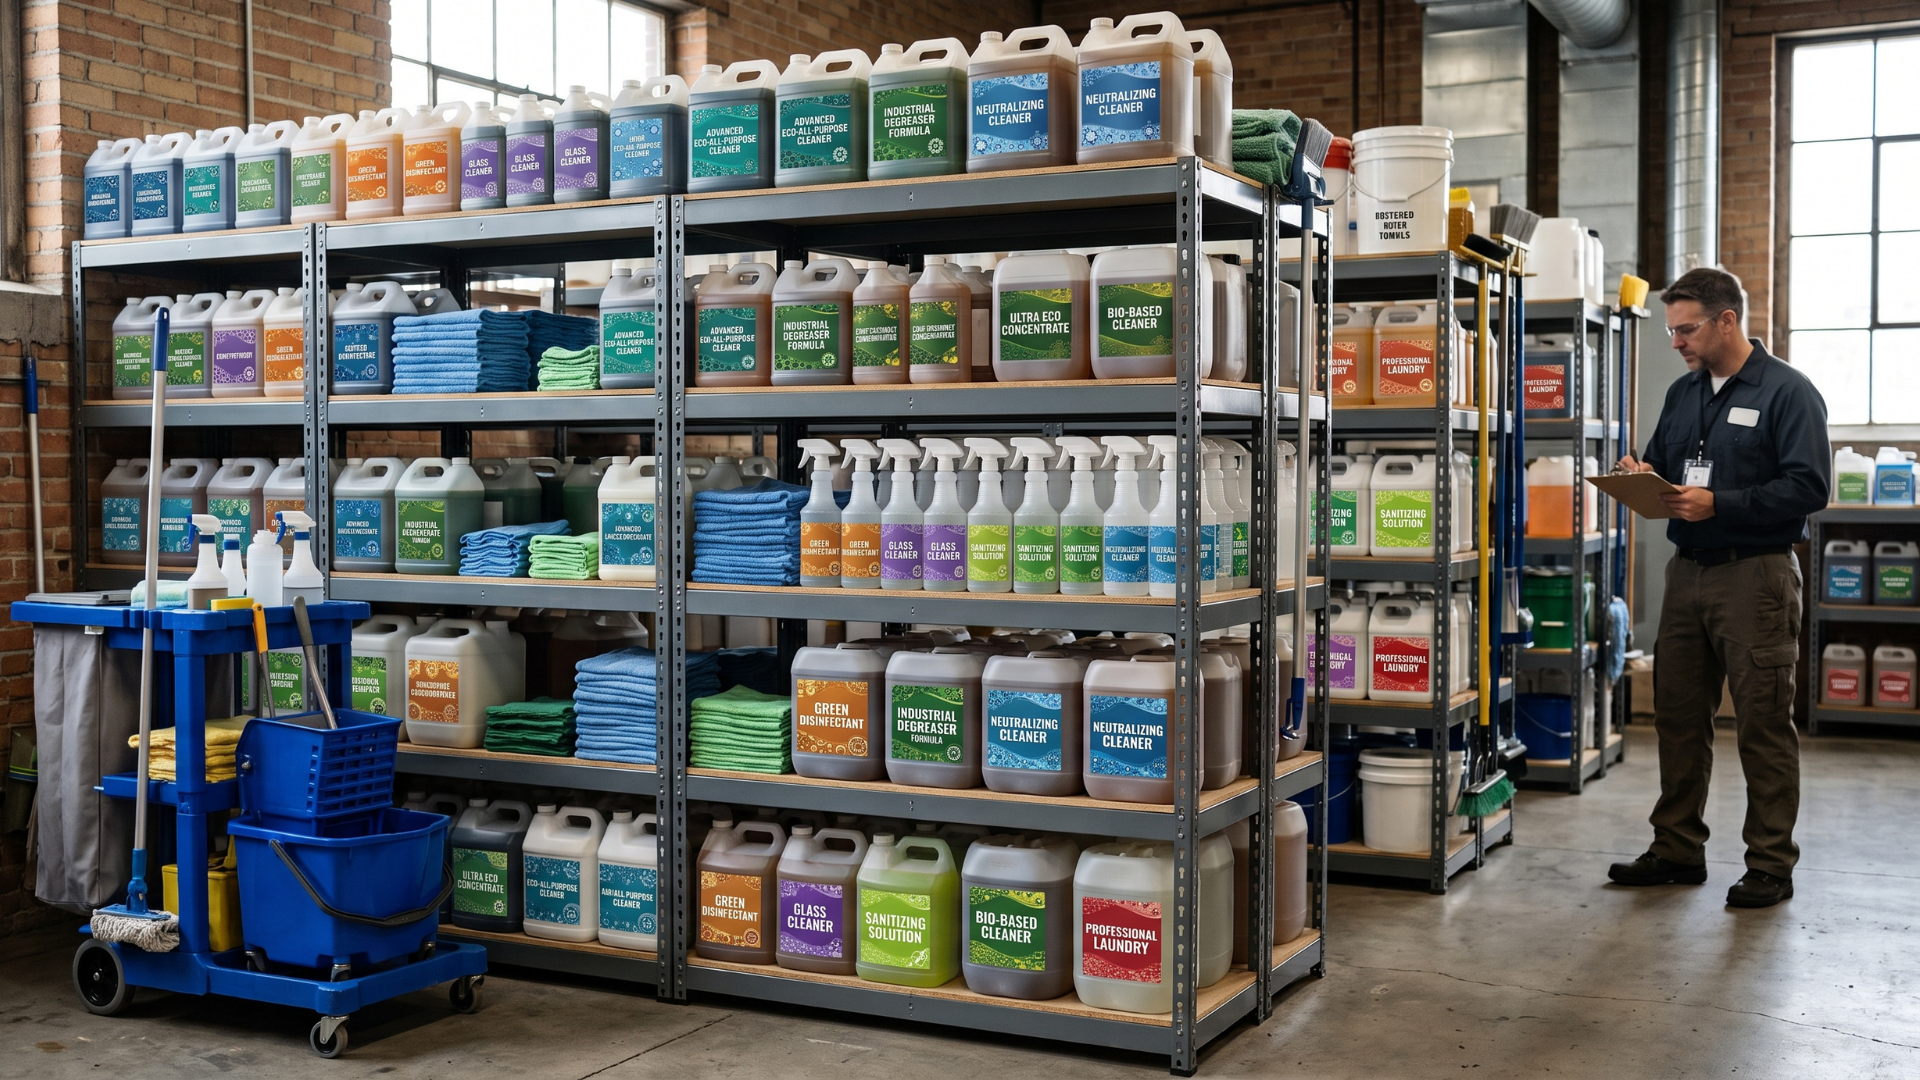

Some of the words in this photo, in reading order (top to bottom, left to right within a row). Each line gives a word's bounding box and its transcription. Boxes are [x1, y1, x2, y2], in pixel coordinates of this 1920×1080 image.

[1085, 87, 1156, 106] NEUTRALIZING
[884, 102, 936, 117] INDUSTRIAL
[975, 98, 1044, 116] NEUTRALIZING
[1098, 101, 1143, 116] CLEANER
[794, 114, 835, 126] ADVANCED
[883, 113, 935, 128] DEGREASER
[988, 112, 1032, 126] CLEANER
[706, 125, 744, 137] ADVANCED
[782, 123, 848, 138] ECO-ALL-PURPOSE
[888, 124, 931, 138] FORMULA
[694, 133, 757, 147] ECO-ALL-PURPOSE
[797, 134, 832, 146] CLEANER
[565, 147, 587, 157] GLASS
[709, 144, 741, 155] CLEANER
[469, 158, 489, 168] GLASS
[511, 162, 540, 173] CLEANER
[560, 155, 591, 167] CLEANER
[465, 166, 493, 177] CLEANER
[1010, 312, 1039, 324] ULTRA
[1042, 311, 1061, 322] ECO
[1107, 305, 1163, 319] BIO-BASED
[783, 320, 829, 331] INDUSTRIAL
[1001, 322, 1070, 336] CONCENTRATE
[1112, 318, 1158, 331] CLEANER
[783, 330, 830, 341] DEGREASER
[616, 346, 642, 355] CLEANER
[712, 343, 741, 352] CLEANER
[787, 340, 826, 351] FORMULA
[1382, 357, 1431, 365] PROFESSIONAL
[1388, 365, 1425, 374] LAUNDRY
[1380, 508, 1426, 519] SANITIZING
[1382, 518, 1423, 528] SOLUTION
[888, 541, 913, 551] GLASS
[930, 542, 957, 552] GLASS
[970, 543, 1006, 552] SANITIZING
[884, 550, 918, 560] CLEANER
[926, 551, 961, 561] CLEANER
[972, 552, 1004, 560] SOLUTION
[1018, 553, 1051, 561] SOLUTION
[1111, 553, 1140, 562] CLEANER
[1375, 654, 1428, 664] PROFESSIONAL
[1383, 663, 1419, 673] LAUNDRY
[814, 702, 849, 717] GREEN
[897, 706, 957, 722] INDUSTRIAL
[799, 715, 865, 730] DISINFECTANT
[897, 720, 957, 736] DEGREASER
[990, 715, 1059, 730] NEUTRALIZING
[1093, 721, 1164, 737] NEUTRALIZING
[999, 729, 1047, 744] CLEANER
[1102, 734, 1153, 751] CLEANER
[462, 870, 484, 882] ULTRA
[484, 871, 498, 883] ECO
[457, 878, 504, 894] CONCENTRATE
[539, 888, 565, 899] CLEANER
[612, 898, 641, 909] CLEANER
[715, 894, 745, 909] GREEN
[702, 905, 758, 922] DISINFECTANT
[793, 902, 827, 918] GLASS
[787, 915, 834, 933] CLEANER
[865, 910, 926, 930] SANITIZING
[975, 910, 1038, 930] BIO-BASED
[868, 926, 922, 944] SOLUTION
[981, 925, 1032, 944] CLEANER
[1085, 922, 1158, 942] PROFESSIONAL
[1093, 937, 1150, 955] LAUNDRY
